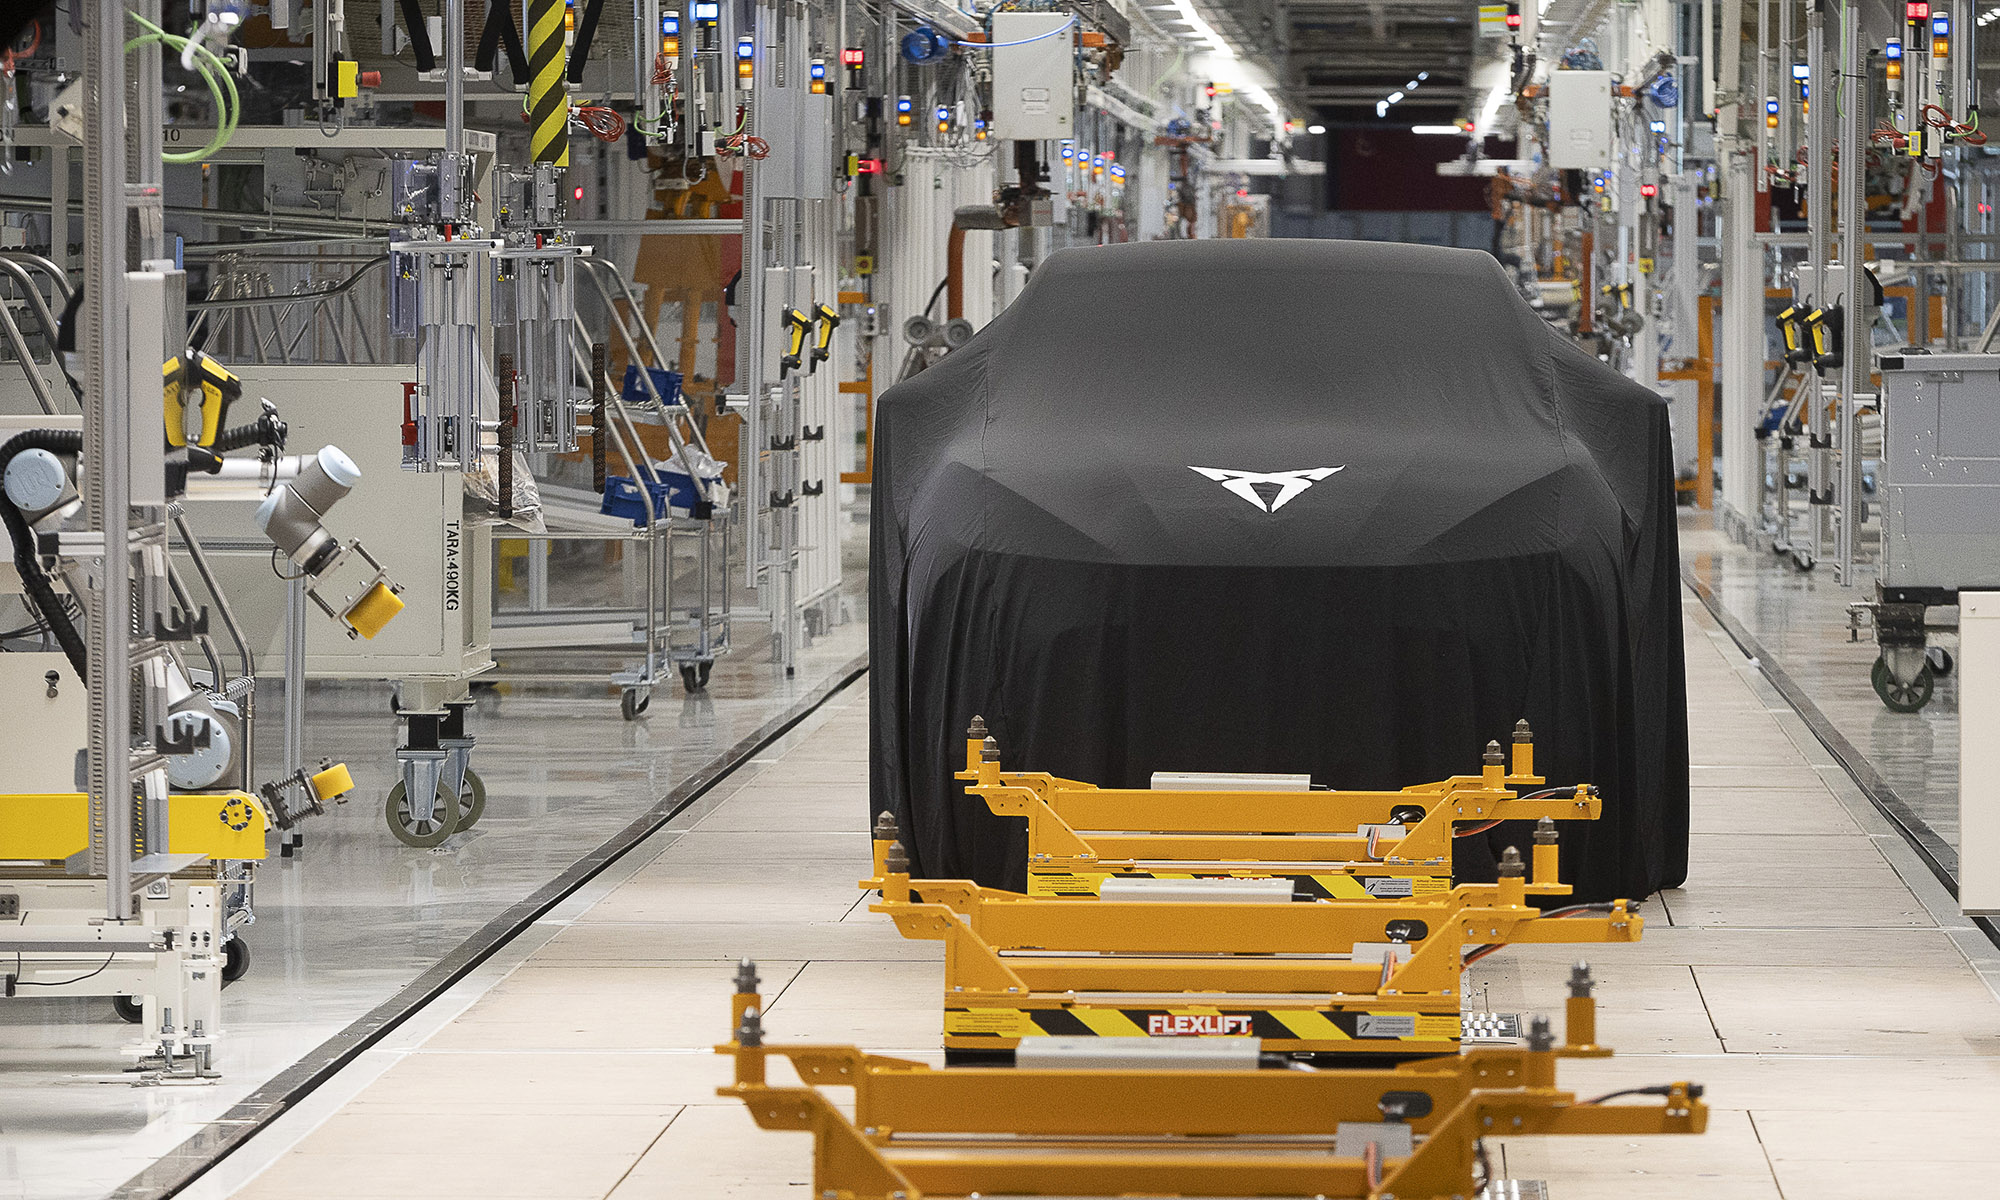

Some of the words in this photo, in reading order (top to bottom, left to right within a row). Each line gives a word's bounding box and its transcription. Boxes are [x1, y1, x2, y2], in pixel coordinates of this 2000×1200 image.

[162, 128, 180, 141] 10
[446, 520, 459, 610] TARA:490KG
[1149, 1015, 1252, 1033] FLEXLIFT
